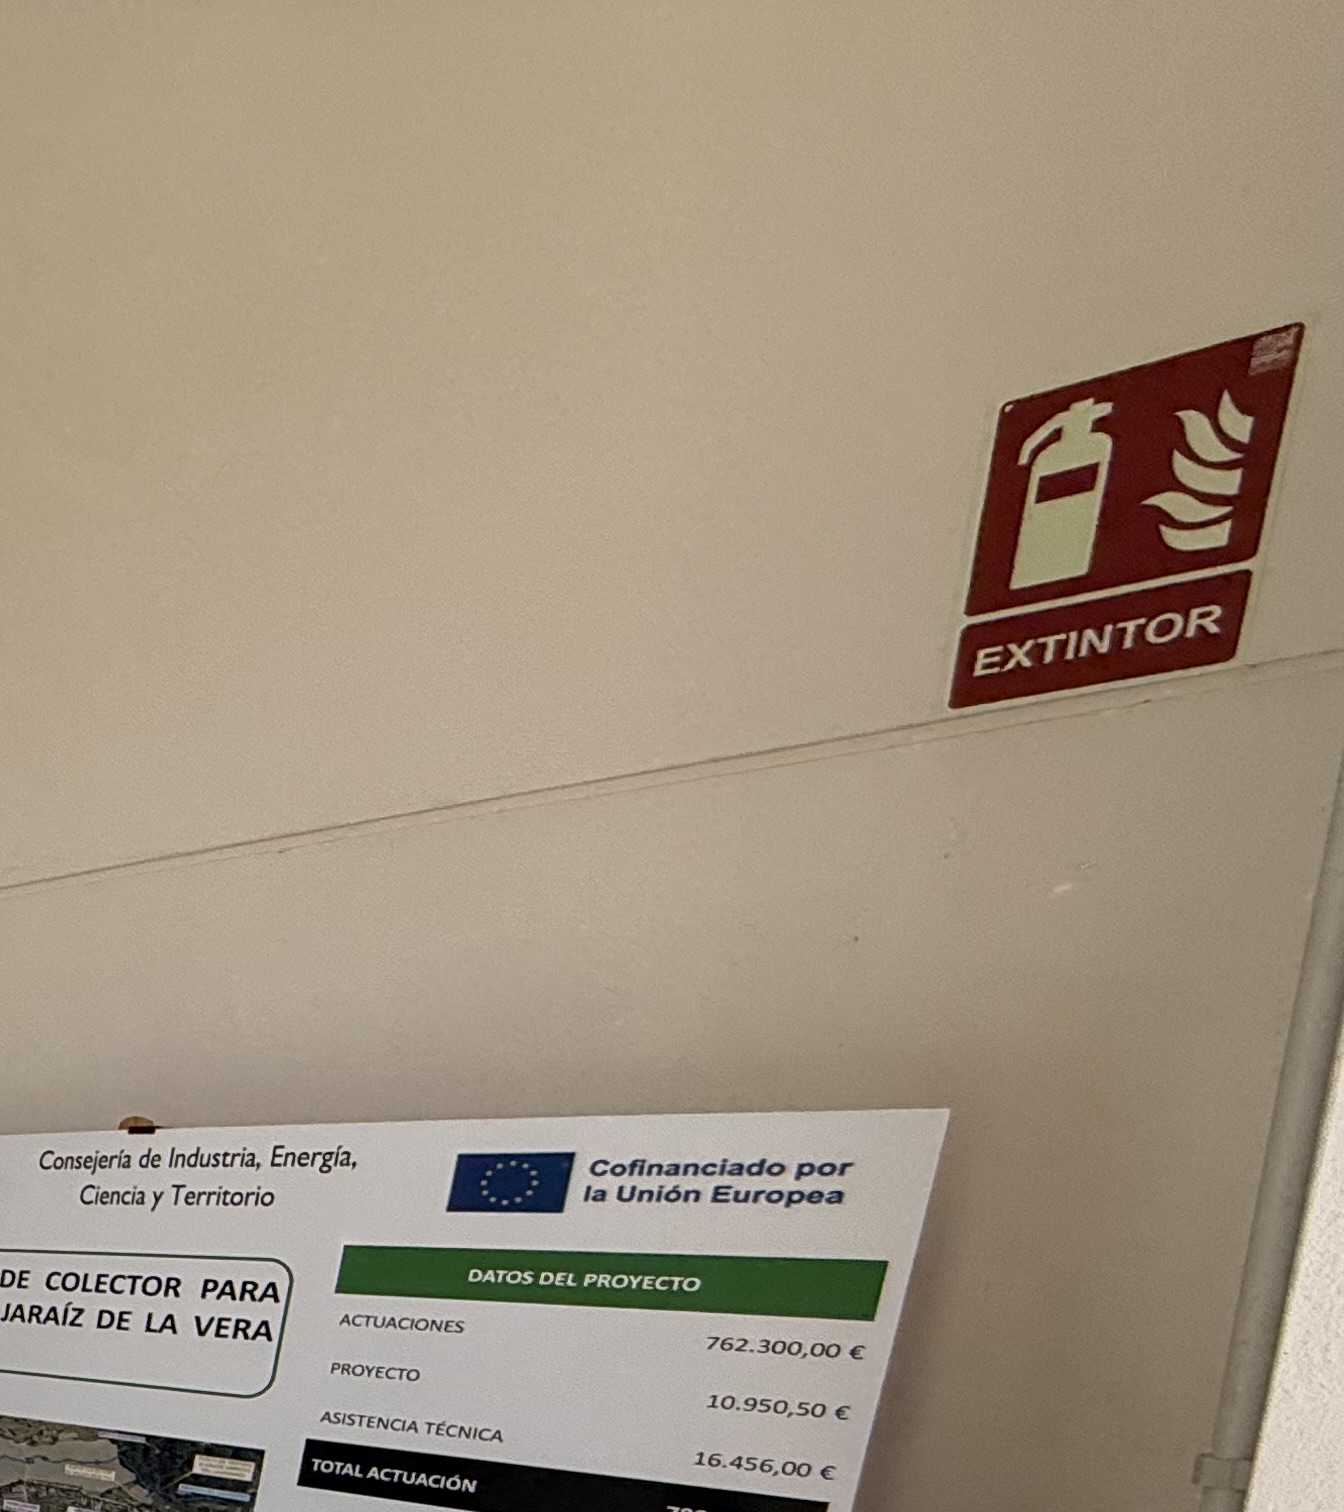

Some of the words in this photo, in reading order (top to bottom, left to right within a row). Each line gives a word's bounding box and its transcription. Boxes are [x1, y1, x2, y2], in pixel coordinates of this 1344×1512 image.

[971, 603, 1224, 678] EXTINTOR
[39, 1148, 132, 1176] Consejería
[138, 1147, 162, 1169] de
[168, 1146, 261, 1172] Industria,
[270, 1144, 357, 1174] Energía,
[589, 1158, 787, 1177] Cofinanciado
[794, 1162, 855, 1182] por
[79, 1183, 146, 1206] Ciencia
[150, 1190, 165, 1213] y
[171, 1183, 275, 1207] Territorio
[583, 1185, 608, 1203] la
[616, 1184, 702, 1204] Unión
[710, 1185, 846, 1209] Europea
[0, 1269, 31, 1290] DE
[45, 1271, 182, 1298] COLECTOR
[200, 1278, 281, 1304] PARA
[467, 1268, 535, 1285] DATOS
[538, 1271, 577, 1287] DEL
[583, 1273, 702, 1292] PROYECTO
[0, 1301, 85, 1328] JARAÍZ
[96, 1309, 133, 1332] DE
[144, 1312, 178, 1335] LA
[194, 1315, 273, 1343] VERA
[338, 1313, 465, 1334] ACTUACIONES
[707, 1336, 842, 1359] 762.300,00
[848, 1344, 866, 1361] €
[330, 1362, 421, 1382] PROYECTO
[706, 1394, 828, 1419] 10.950,50
[834, 1405, 851, 1421] €
[319, 1411, 419, 1434] ASISTENCIA
[424, 1420, 504, 1444] TÉCNICA
[311, 1458, 364, 1478] TOTAL
[366, 1466, 478, 1494] ACTUACIÓN
[693, 1451, 813, 1478] 16.456,00
[819, 1465, 837, 1481] €
